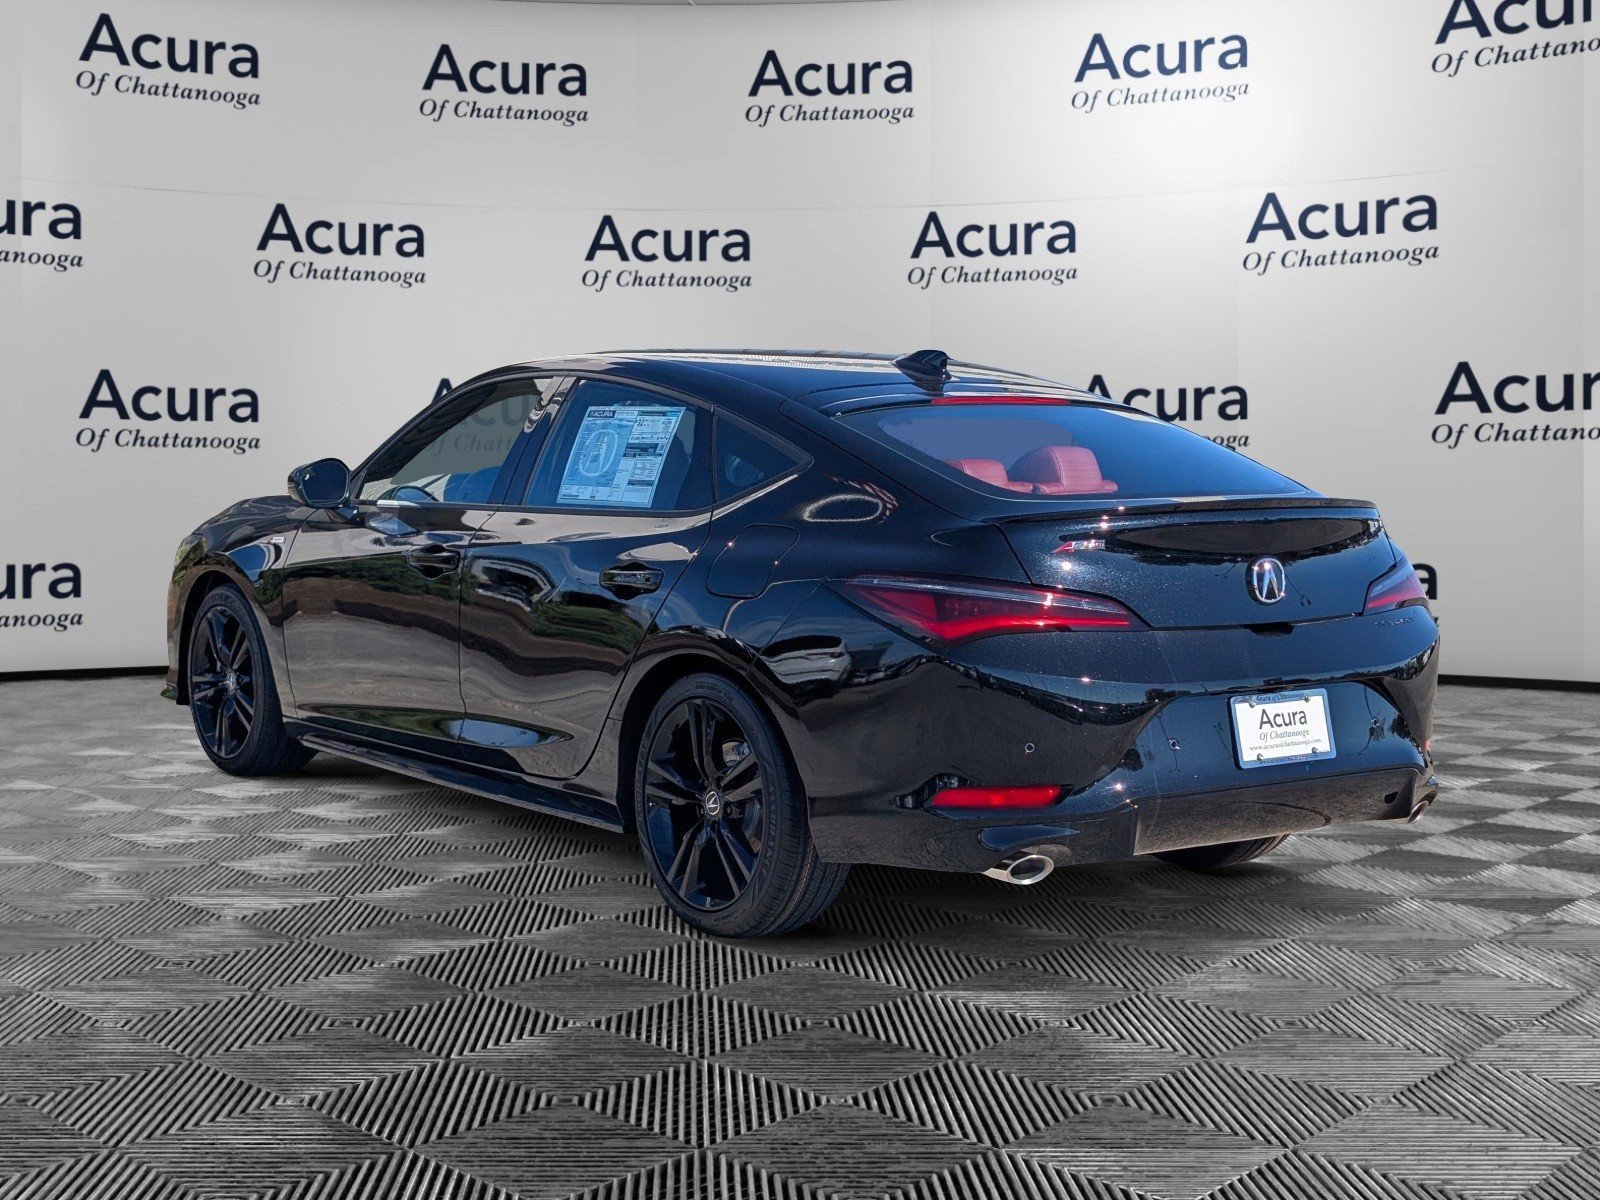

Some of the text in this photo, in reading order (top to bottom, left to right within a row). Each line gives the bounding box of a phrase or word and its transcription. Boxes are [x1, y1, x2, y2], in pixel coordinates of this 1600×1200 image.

[78, 12, 259, 79] Acura
[1074, 33, 1248, 83] Acura
[422, 43, 588, 97] Acura
[748, 49, 914, 97] Acura
[1431, 50, 1468, 78] Of
[75, 70, 261, 110] Of Chattanooga
[1071, 84, 1249, 114] Of Chattanooga
[419, 99, 589, 126] Of Chattanooga
[745, 104, 914, 127] Of Chattanooga
[256, 203, 426, 258] Acura
[1245, 192, 1438, 244] Acura
[584, 214, 752, 263] Acura
[910, 211, 1077, 259] Acura
[253, 260, 427, 289] Of Chattanooga
[1242, 246, 1439, 274] Of Chattanooga
[581, 269, 752, 292] Of Chattanooga
[907, 266, 1078, 289] Of Chattanooga
[78, 368, 259, 424] Acura
[75, 427, 260, 455] Of Chattanooga
[1431, 423, 1469, 450] Of
[1259, 708, 1307, 729] Acura
[1259, 729, 1309, 743] Of Chattanooga
